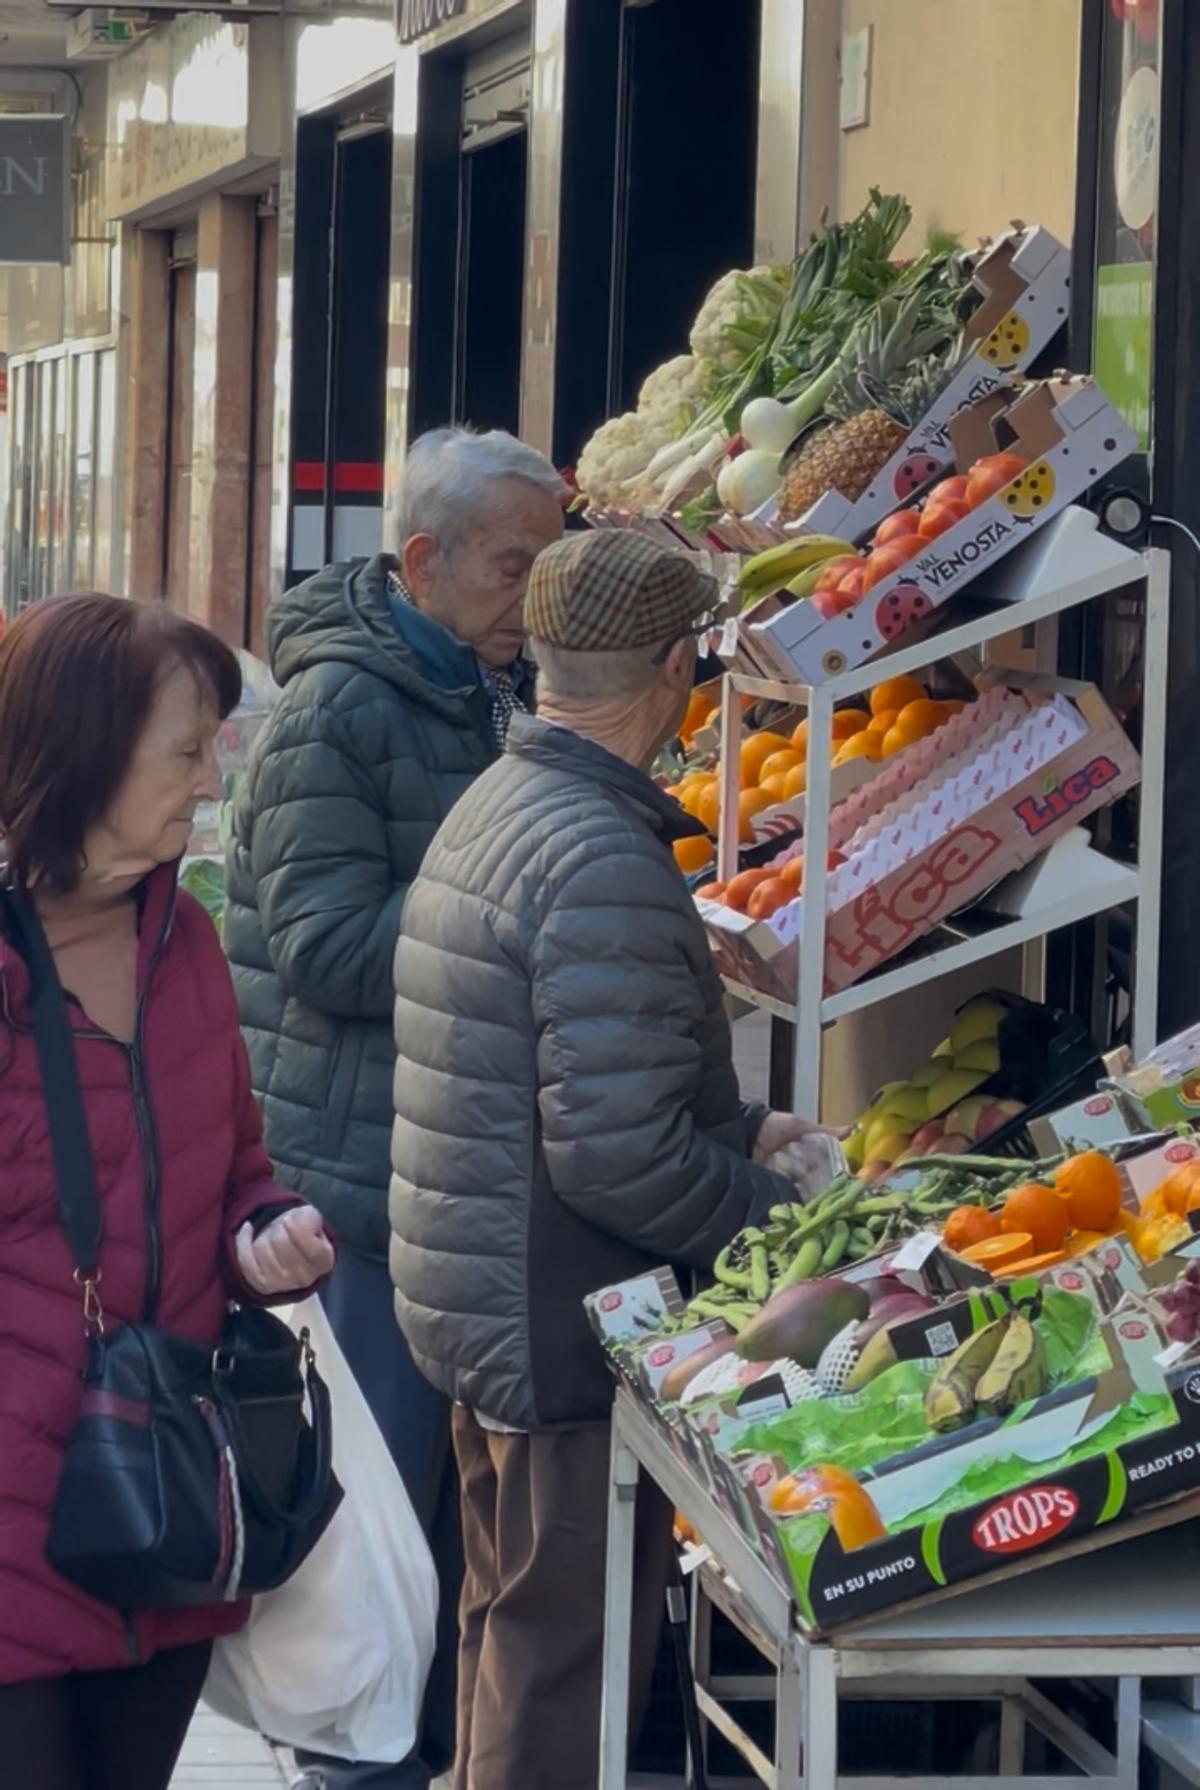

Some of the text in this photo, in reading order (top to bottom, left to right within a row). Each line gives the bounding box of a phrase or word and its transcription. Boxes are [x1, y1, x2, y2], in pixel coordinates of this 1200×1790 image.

[0, 156, 48, 195] N
[916, 553, 941, 572] VAL
[924, 521, 1012, 587] VENOSTA
[1012, 755, 1121, 837] Lica
[1128, 1453, 1174, 1481] READY
[1175, 1446, 1195, 1463] TO
[976, 1488, 1077, 1548] TROPS
[823, 1555, 917, 1602] EN SU PUNTO
